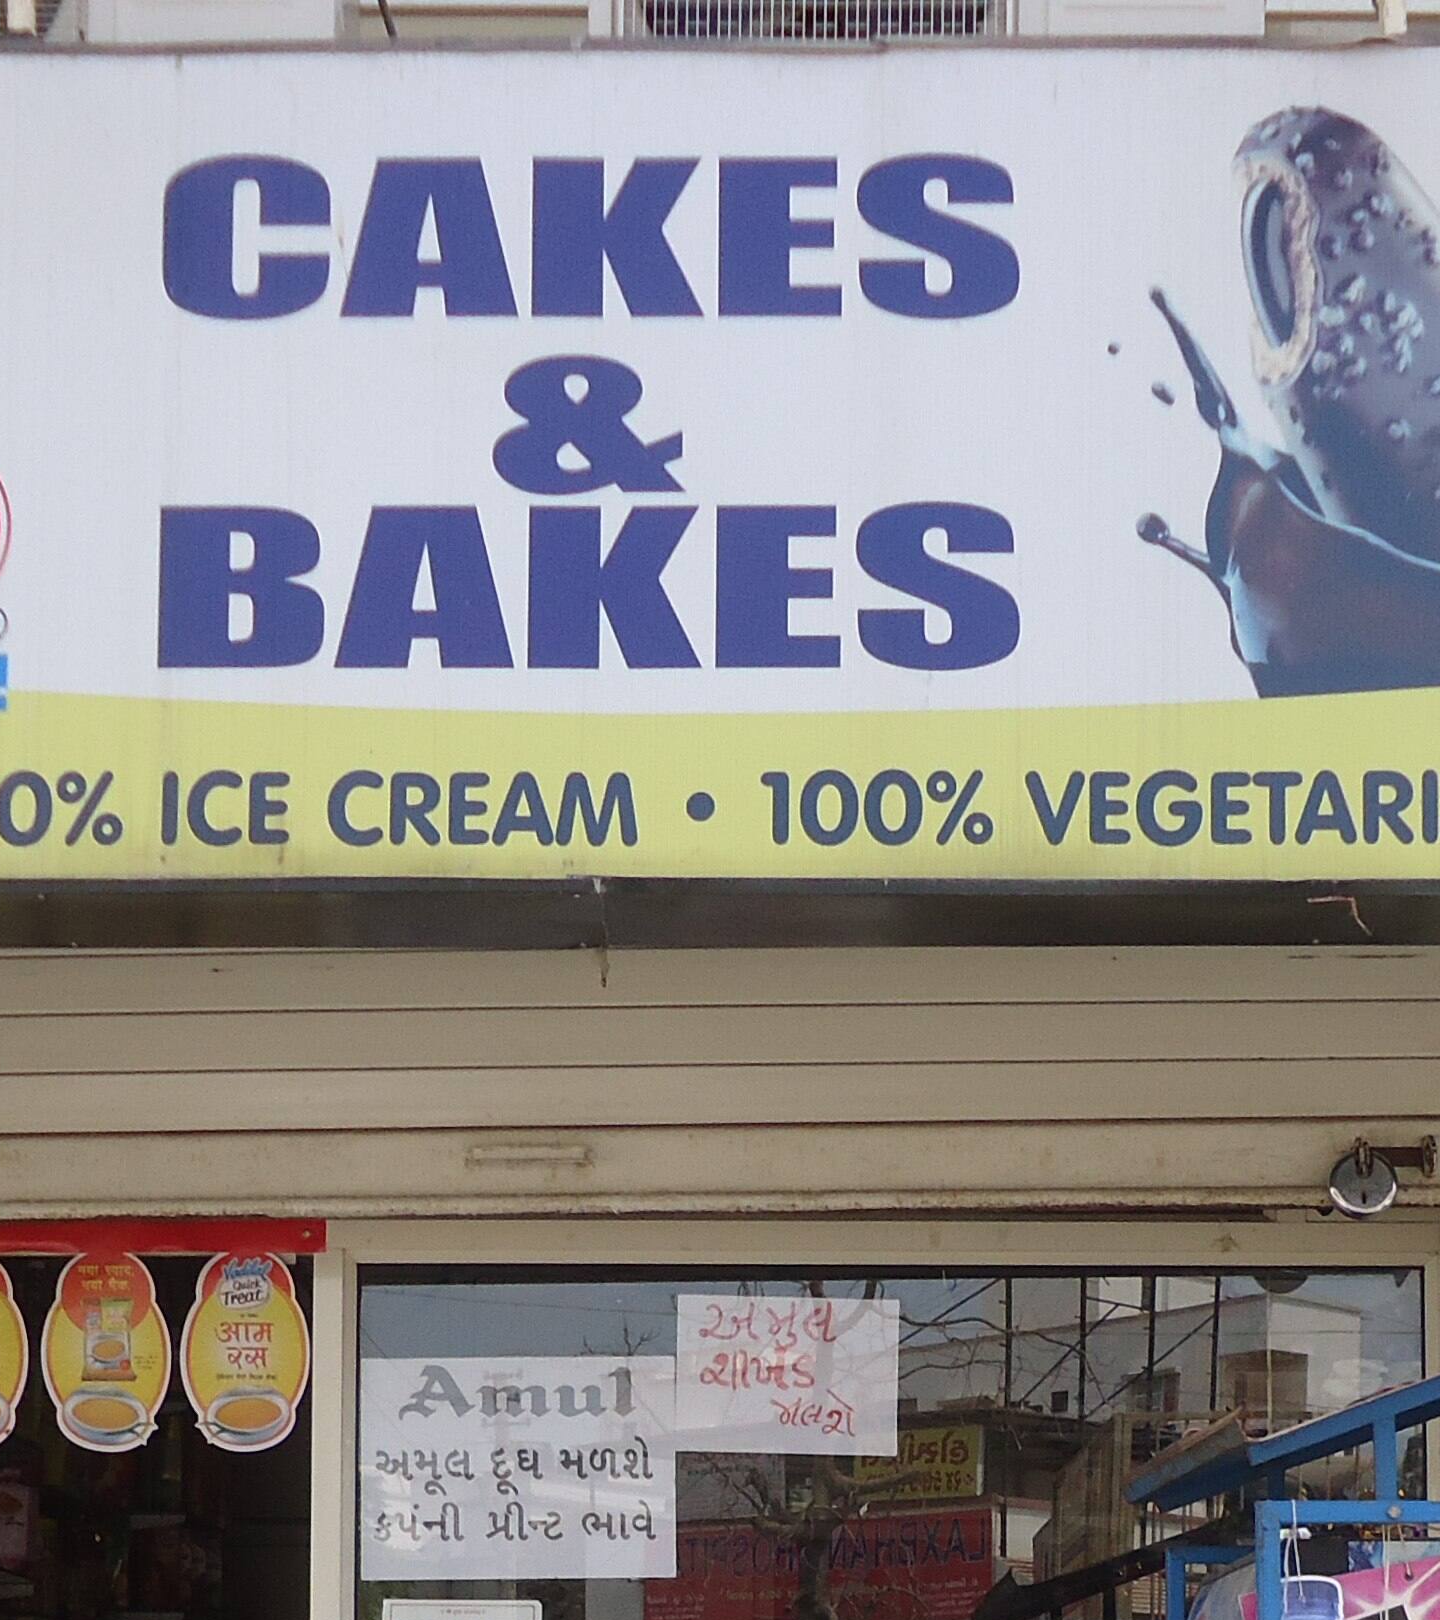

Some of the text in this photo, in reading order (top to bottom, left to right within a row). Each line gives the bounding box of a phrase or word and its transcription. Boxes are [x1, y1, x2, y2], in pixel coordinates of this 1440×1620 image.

[163, 153, 1020, 320] CAKES
[492, 354, 686, 495] &
[158, 502, 1020, 670] BAKES
[163, 770, 290, 846] ICE
[327, 770, 638, 847] CREAM
[761, 770, 993, 846] 100%
[223, 1290, 265, 1306] Treat
[215, 1321, 274, 1343] आम
[226, 1347, 268, 1369] रस
[399, 1365, 637, 1421] Amul
[375, 1448, 475, 1496] અમૂલ
[559, 1436, 653, 1480] મળશે
[486, 1501, 564, 1541] પ્રીન્ટ
[581, 1500, 657, 1541] ભાવે
